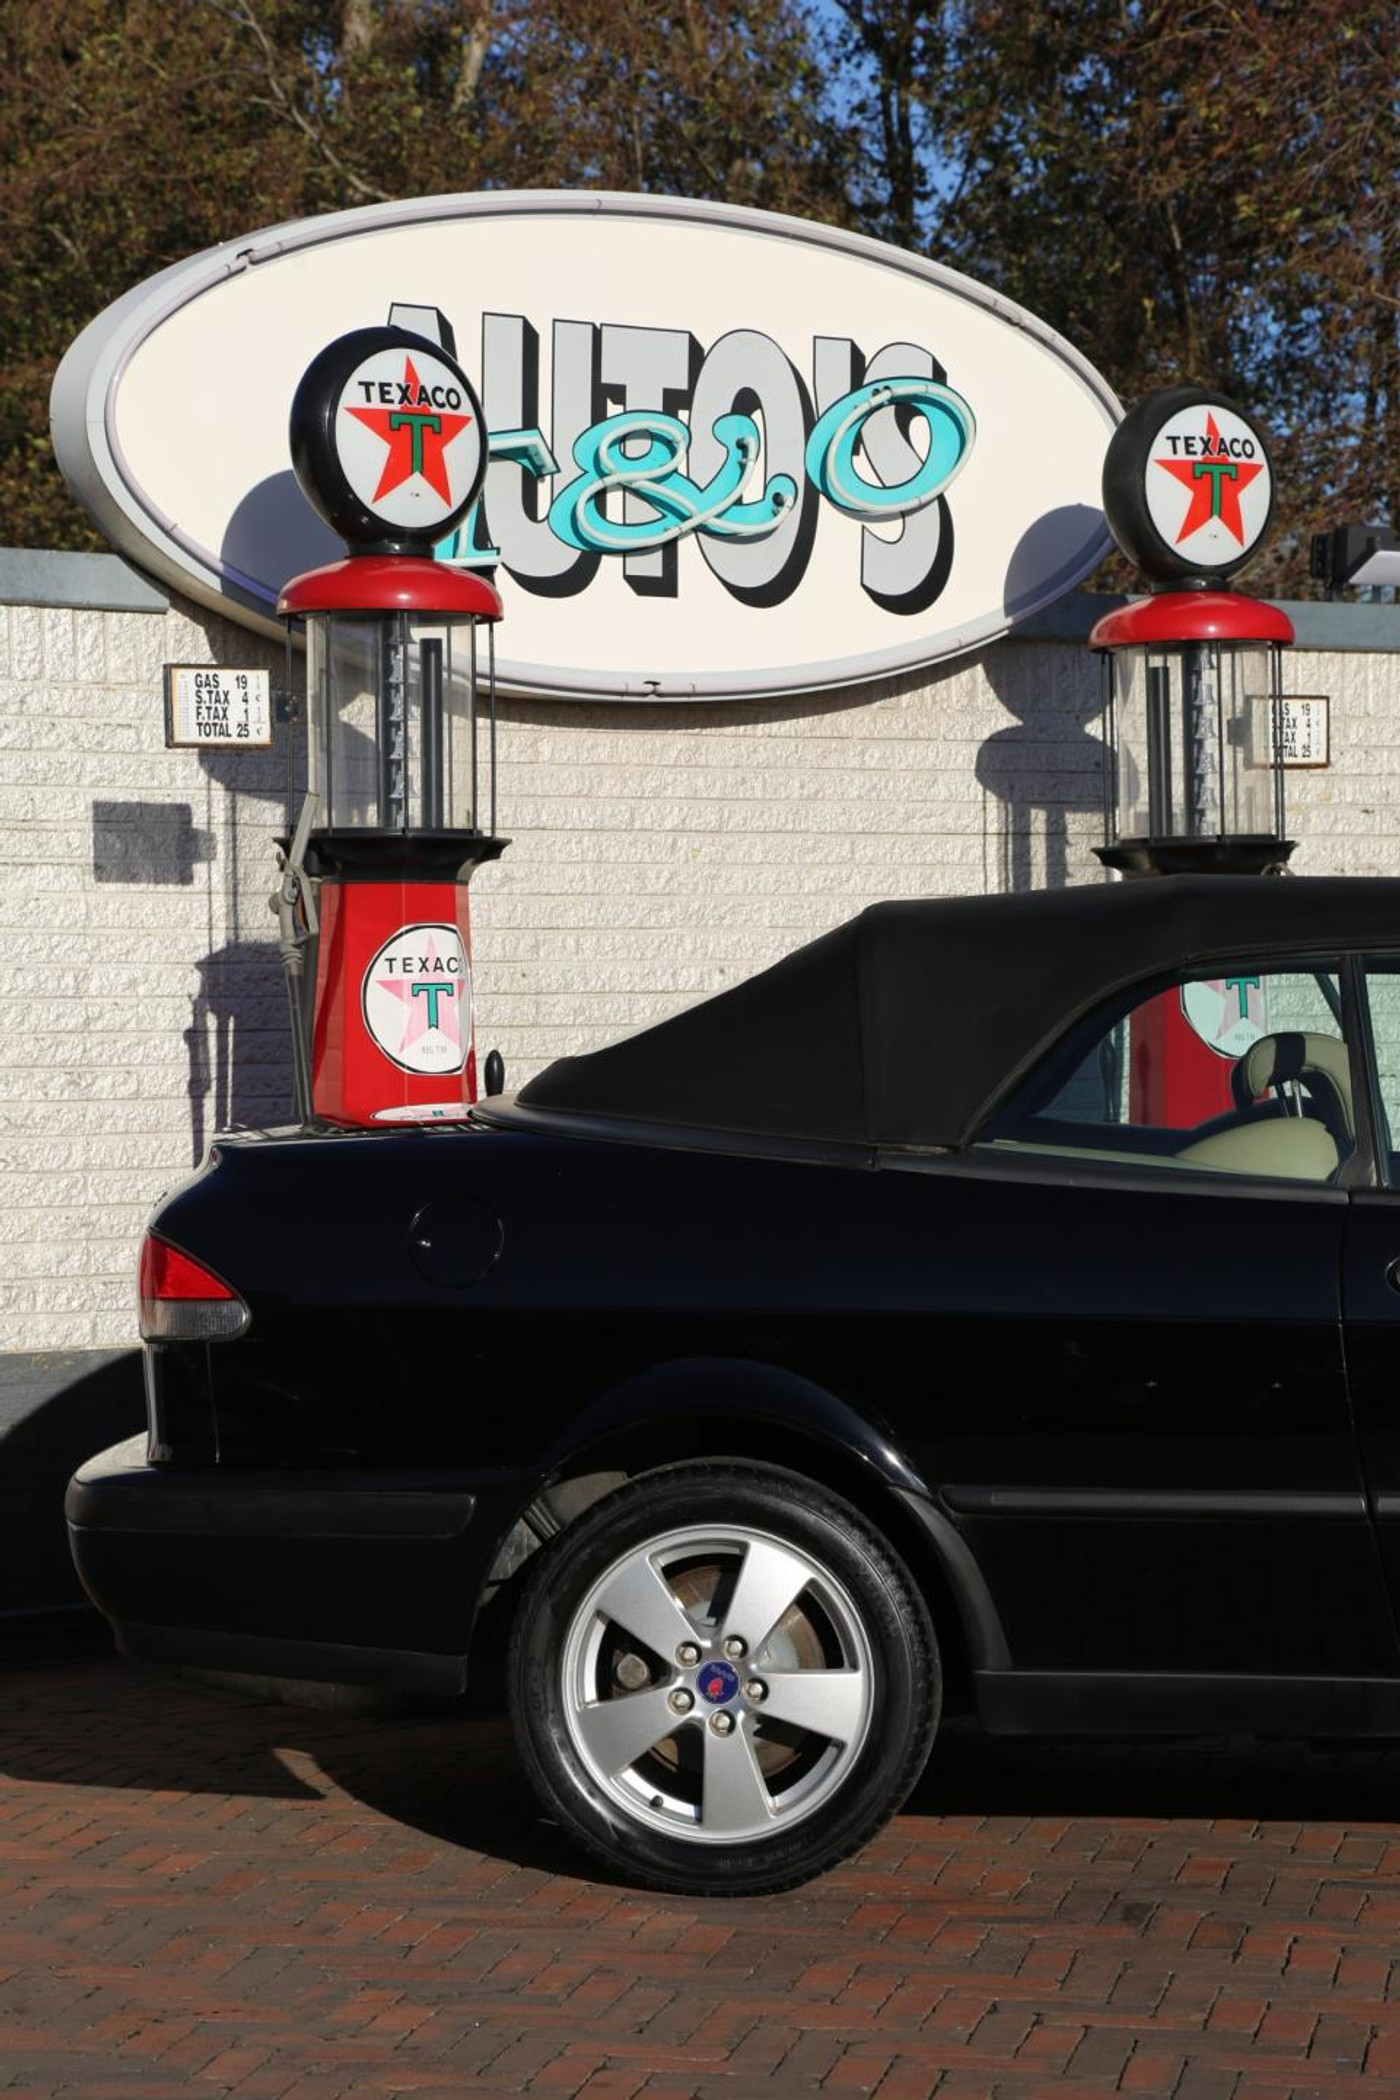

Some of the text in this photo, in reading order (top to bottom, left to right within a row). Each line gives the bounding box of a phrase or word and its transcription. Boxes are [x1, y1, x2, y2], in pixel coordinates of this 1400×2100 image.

[358, 380, 461, 410] TEXACO
[389, 411, 442, 475] T
[1166, 435, 1255, 459] TEXACO
[387, 302, 956, 616] UTO'S
[1193, 462, 1237, 518] T
[195, 673, 220, 689] GAS
[235, 675, 248, 689] 19
[195, 690, 230, 705] S.TAX
[242, 691, 249, 705] 4
[196, 707, 229, 721] F.TAX
[244, 708, 249, 722] 1
[196, 722, 232, 737] TOTAL
[236, 723, 250, 738] 25
[411, 983, 454, 1029] T
[1225, 977, 1260, 1019] T
